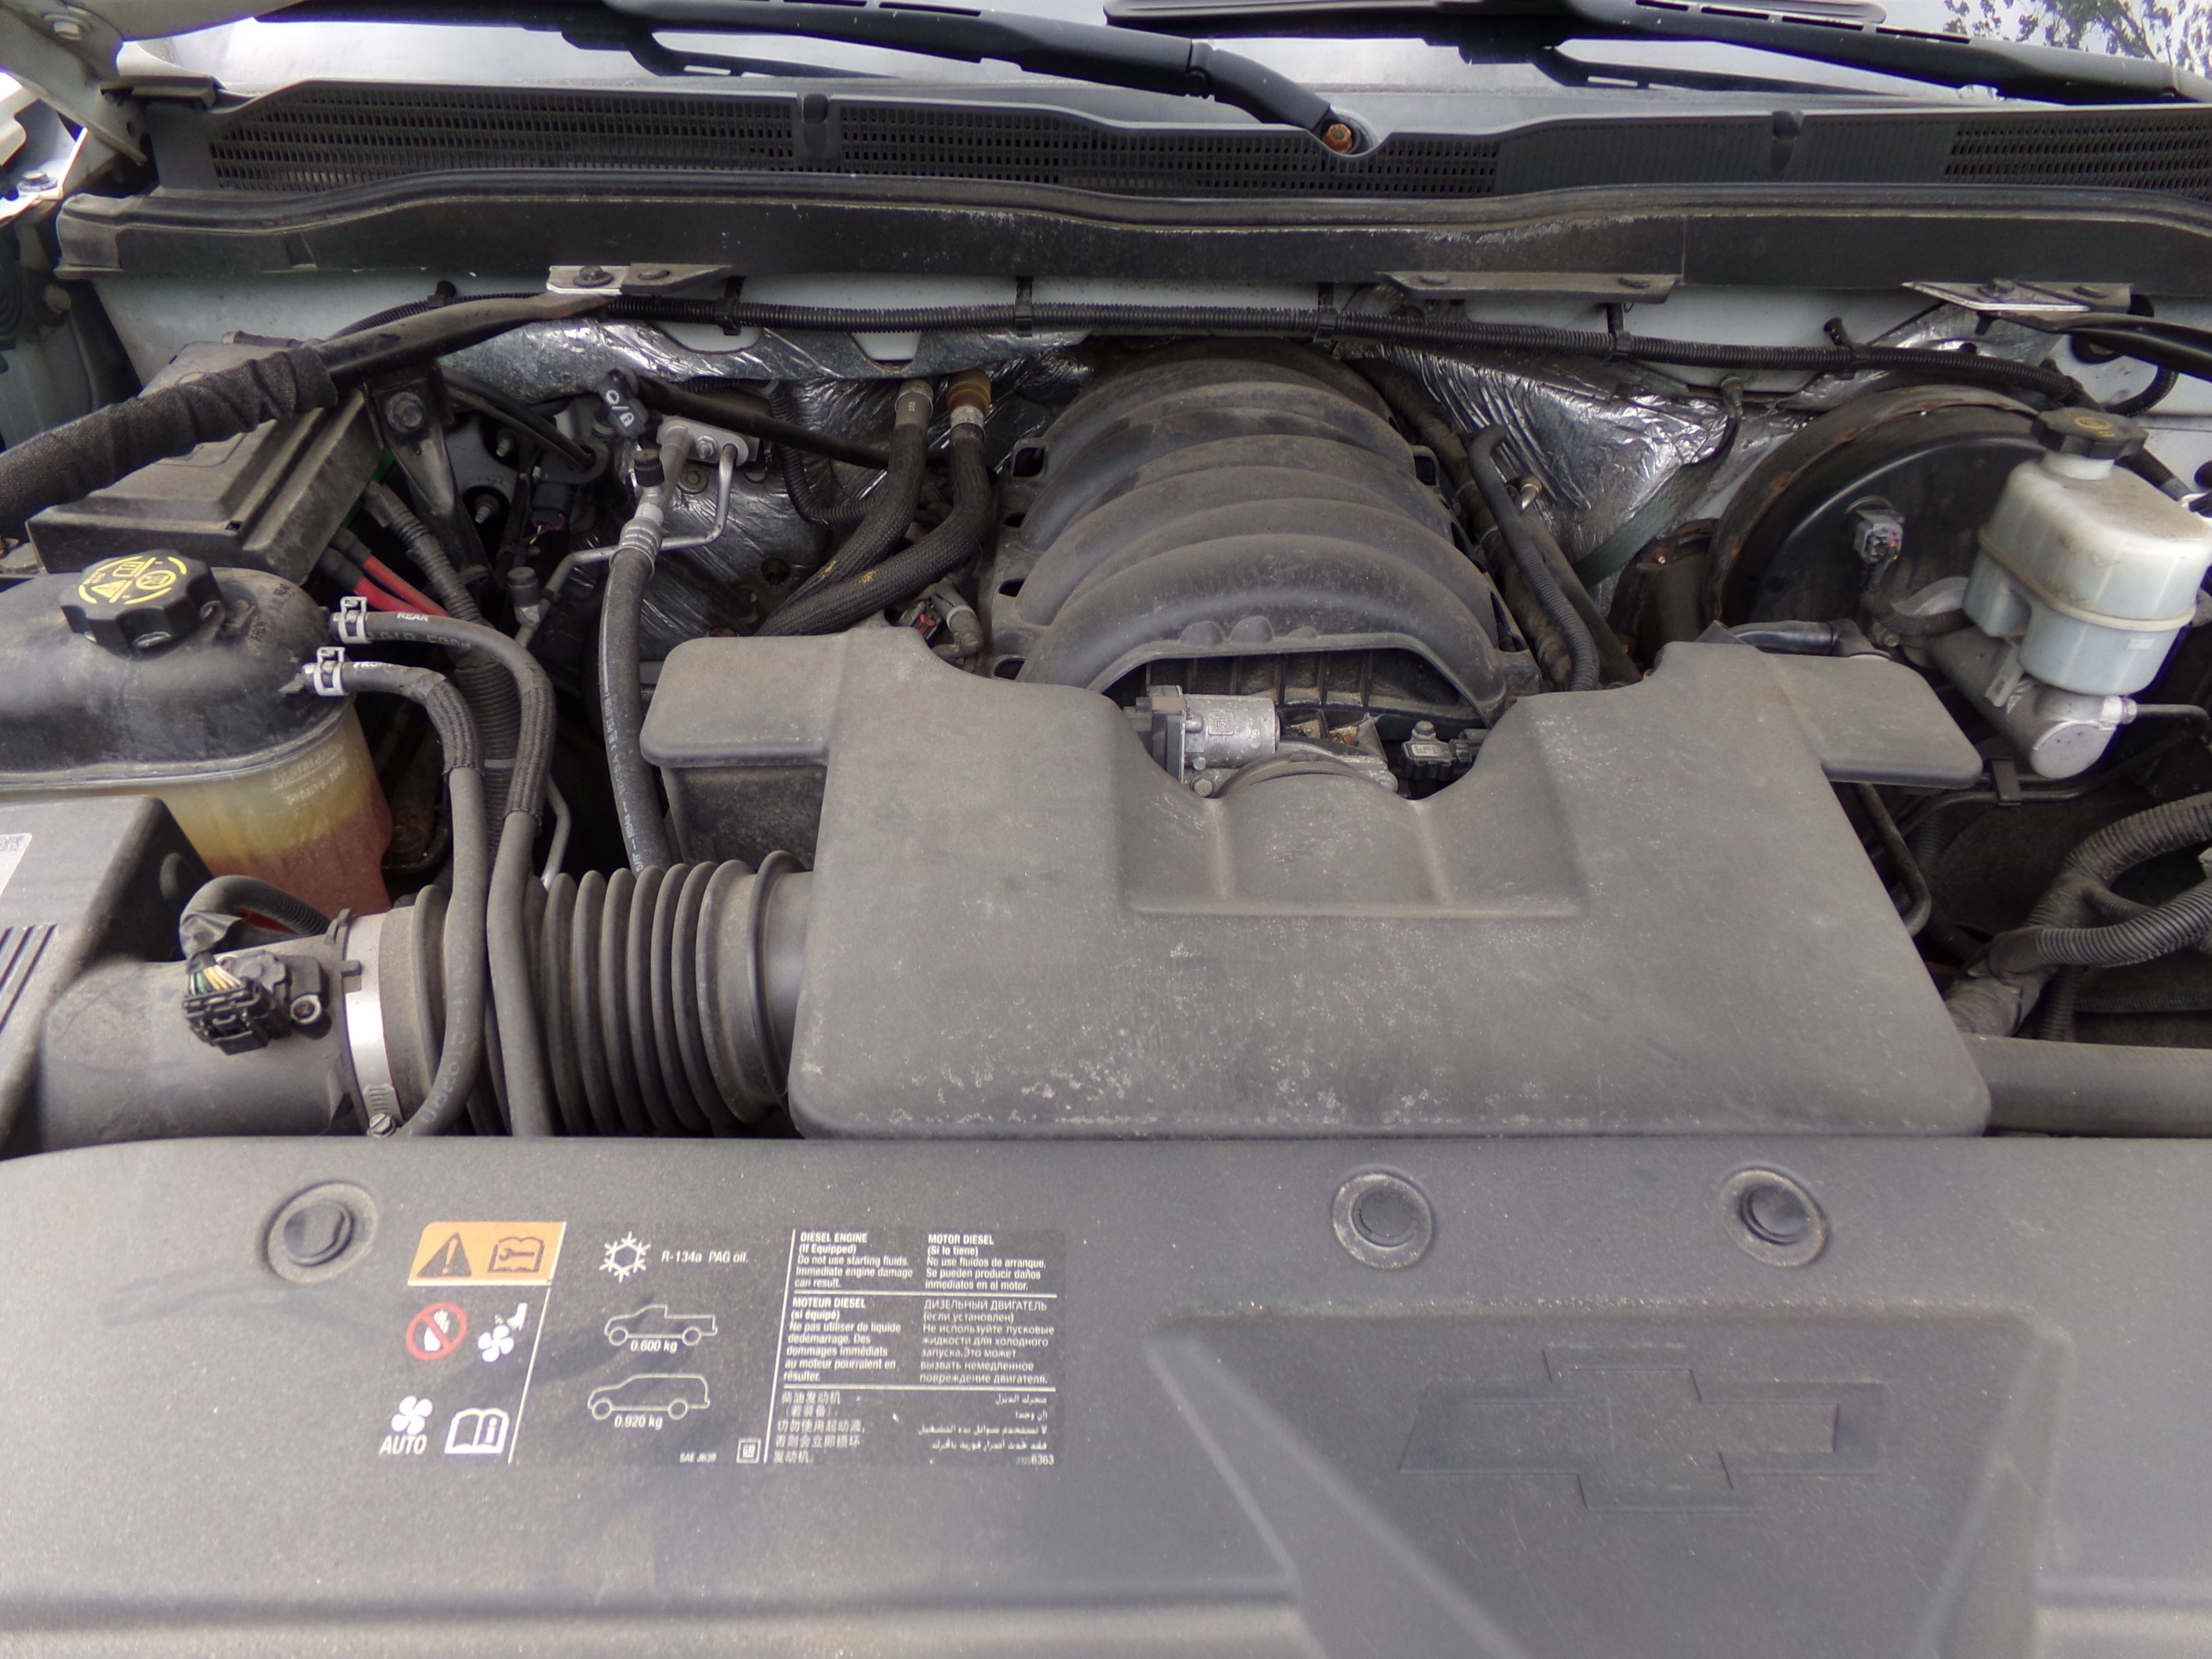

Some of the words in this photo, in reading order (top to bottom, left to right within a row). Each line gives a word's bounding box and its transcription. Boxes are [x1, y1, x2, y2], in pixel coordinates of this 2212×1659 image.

[397, 612, 428, 622] REAR
[800, 1232, 831, 1242] DIESEL
[834, 1232, 867, 1243] ENGINE
[928, 1234, 960, 1245] MOTOR
[963, 1235, 994, 1245] DIESEL
[799, 1243, 809, 1254] (If
[811, 1244, 856, 1255] Equipped)
[927, 1246, 939, 1257] (Si
[942, 1246, 950, 1255] lo
[953, 1246, 978, 1257] tiene)
[661, 1250, 702, 1263] R-134a
[709, 1250, 730, 1263] PAG
[797, 1255, 809, 1264] Do
[812, 1255, 826, 1264] not
[829, 1256, 844, 1265] use
[846, 1255, 880, 1267] starting
[883, 1256, 909, 1266] fluids.
[926, 1257, 938, 1266] No
[941, 1258, 957, 1267] use
[960, 1257, 988, 1267] fluidos
[991, 1258, 1002, 1267] de
[796, 1266, 842, 1276] Immediate
[845, 1268, 875, 1278] engine
[878, 1267, 913, 1279] damage
[926, 1268, 936, 1278] Se
[939, 1269, 972, 1279] pueden
[975, 1269, 1012, 1279] producir
[1014, 1269, 1041, 1280] daños
[794, 1278, 811, 1287] can
[813, 1278, 841, 1288] result.
[925, 1279, 974, 1290] inmediatos
[976, 1281, 987, 1290] en
[990, 1280, 998, 1290] el
[1001, 1281, 1028, 1291] motor.
[792, 1297, 831, 1308] MOTEUR
[834, 1297, 866, 1309] DIESEL
[990, 1300, 1047, 1311] ДВИГАТЕЛЬ
[791, 1310, 803, 1321] (si
[805, 1310, 840, 1322] équipé)
[923, 1311, 950, 1322] (если
[953, 1312, 1014, 1324] установлен)
[790, 1321, 802, 1332] Ne
[804, 1322, 820, 1333] pas
[823, 1322, 854, 1332] utiliser
[857, 1322, 868, 1332] de
[871, 1322, 901, 1334] liquide
[923, 1323, 936, 1333] Не
[939, 1323, 1002, 1335] используйте
[1006, 1325, 1055, 1336] пусковые
[854, 1334, 871, 1344] Des
[923, 1337, 971, 1346] жидкости
[974, 1337, 992, 1347] для
[995, 1337, 1048, 1347] холодного
[663, 1339, 678, 1354] kg
[786, 1346, 837, 1358] dommages
[840, 1346, 888, 1357] immédiats
[984, 1349, 1017, 1358] может
[785, 1359, 797, 1369] au
[799, 1358, 832, 1369] moteur
[834, 1358, 882, 1371] pourraient
[884, 1360, 896, 1370] en
[920, 1360, 961, 1370] вызвать
[964, 1361, 1034, 1372] немедленное
[920, 1373, 991, 1384] повреждение
[614, 1414, 646, 1428] 0.920
[649, 1414, 663, 1430] kg
[379, 1434, 428, 1455] AUTO
